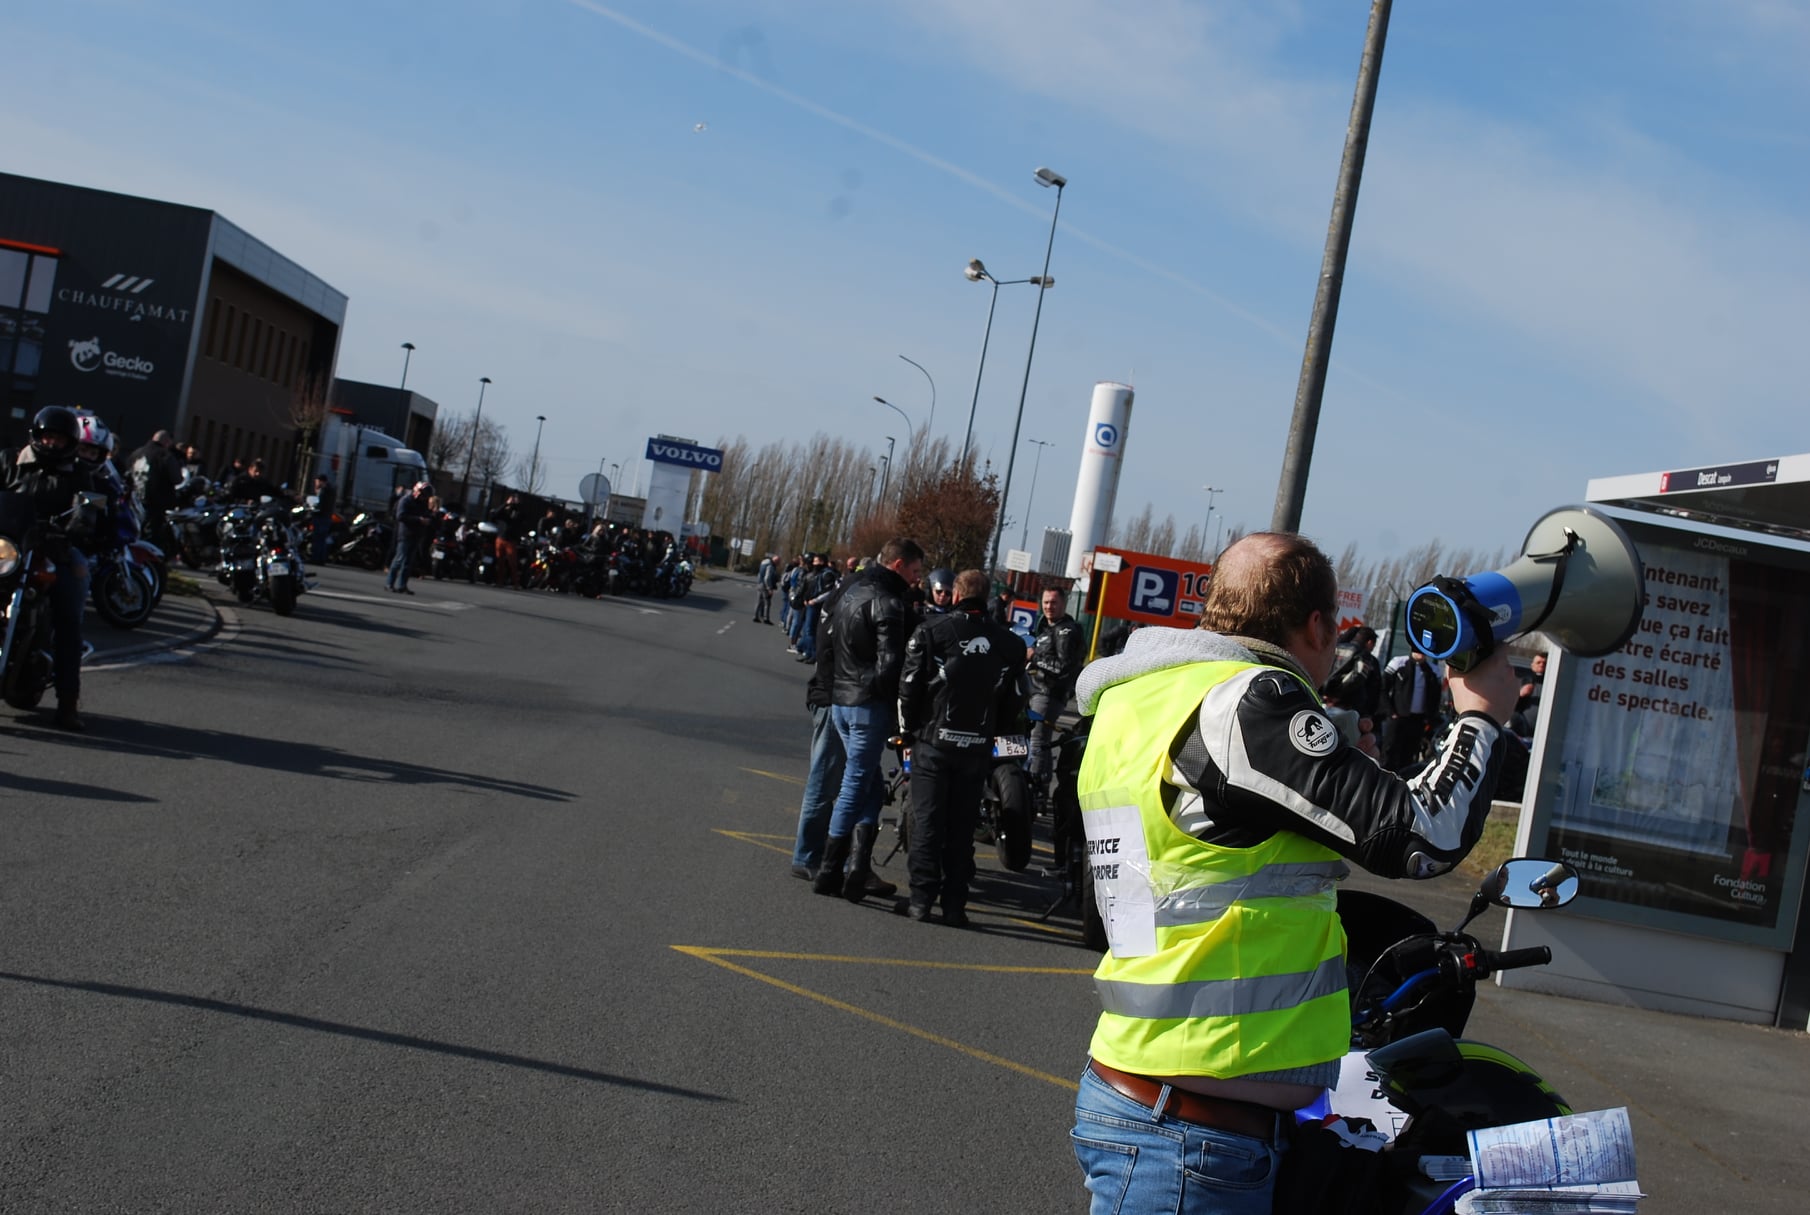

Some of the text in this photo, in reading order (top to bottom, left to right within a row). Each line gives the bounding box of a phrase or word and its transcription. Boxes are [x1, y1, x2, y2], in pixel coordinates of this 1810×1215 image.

[58, 288, 190, 322] CHAUFFAMAT
[103, 351, 154, 373] Gecko
[651, 444, 720, 465] VOLVO
[1694, 537, 1748, 556] JCDecaux
[1641, 562, 1724, 595] intenant,
[1656, 595, 1711, 616] savez
[1640, 619, 1729, 645] ue ça fait
[1617, 640, 1721, 671] tre écarté
[1592, 659, 1689, 690] des salles
[1588, 684, 1713, 721] de spectacle.
[1088, 838, 1120, 855] ERVICE
[1561, 848, 1618, 865] Tout le monde
[1587, 860, 1593, 870] à
[1594, 862, 1602, 871] la
[1604, 865, 1633, 876] culture
[1713, 874, 1766, 892] Fondation
